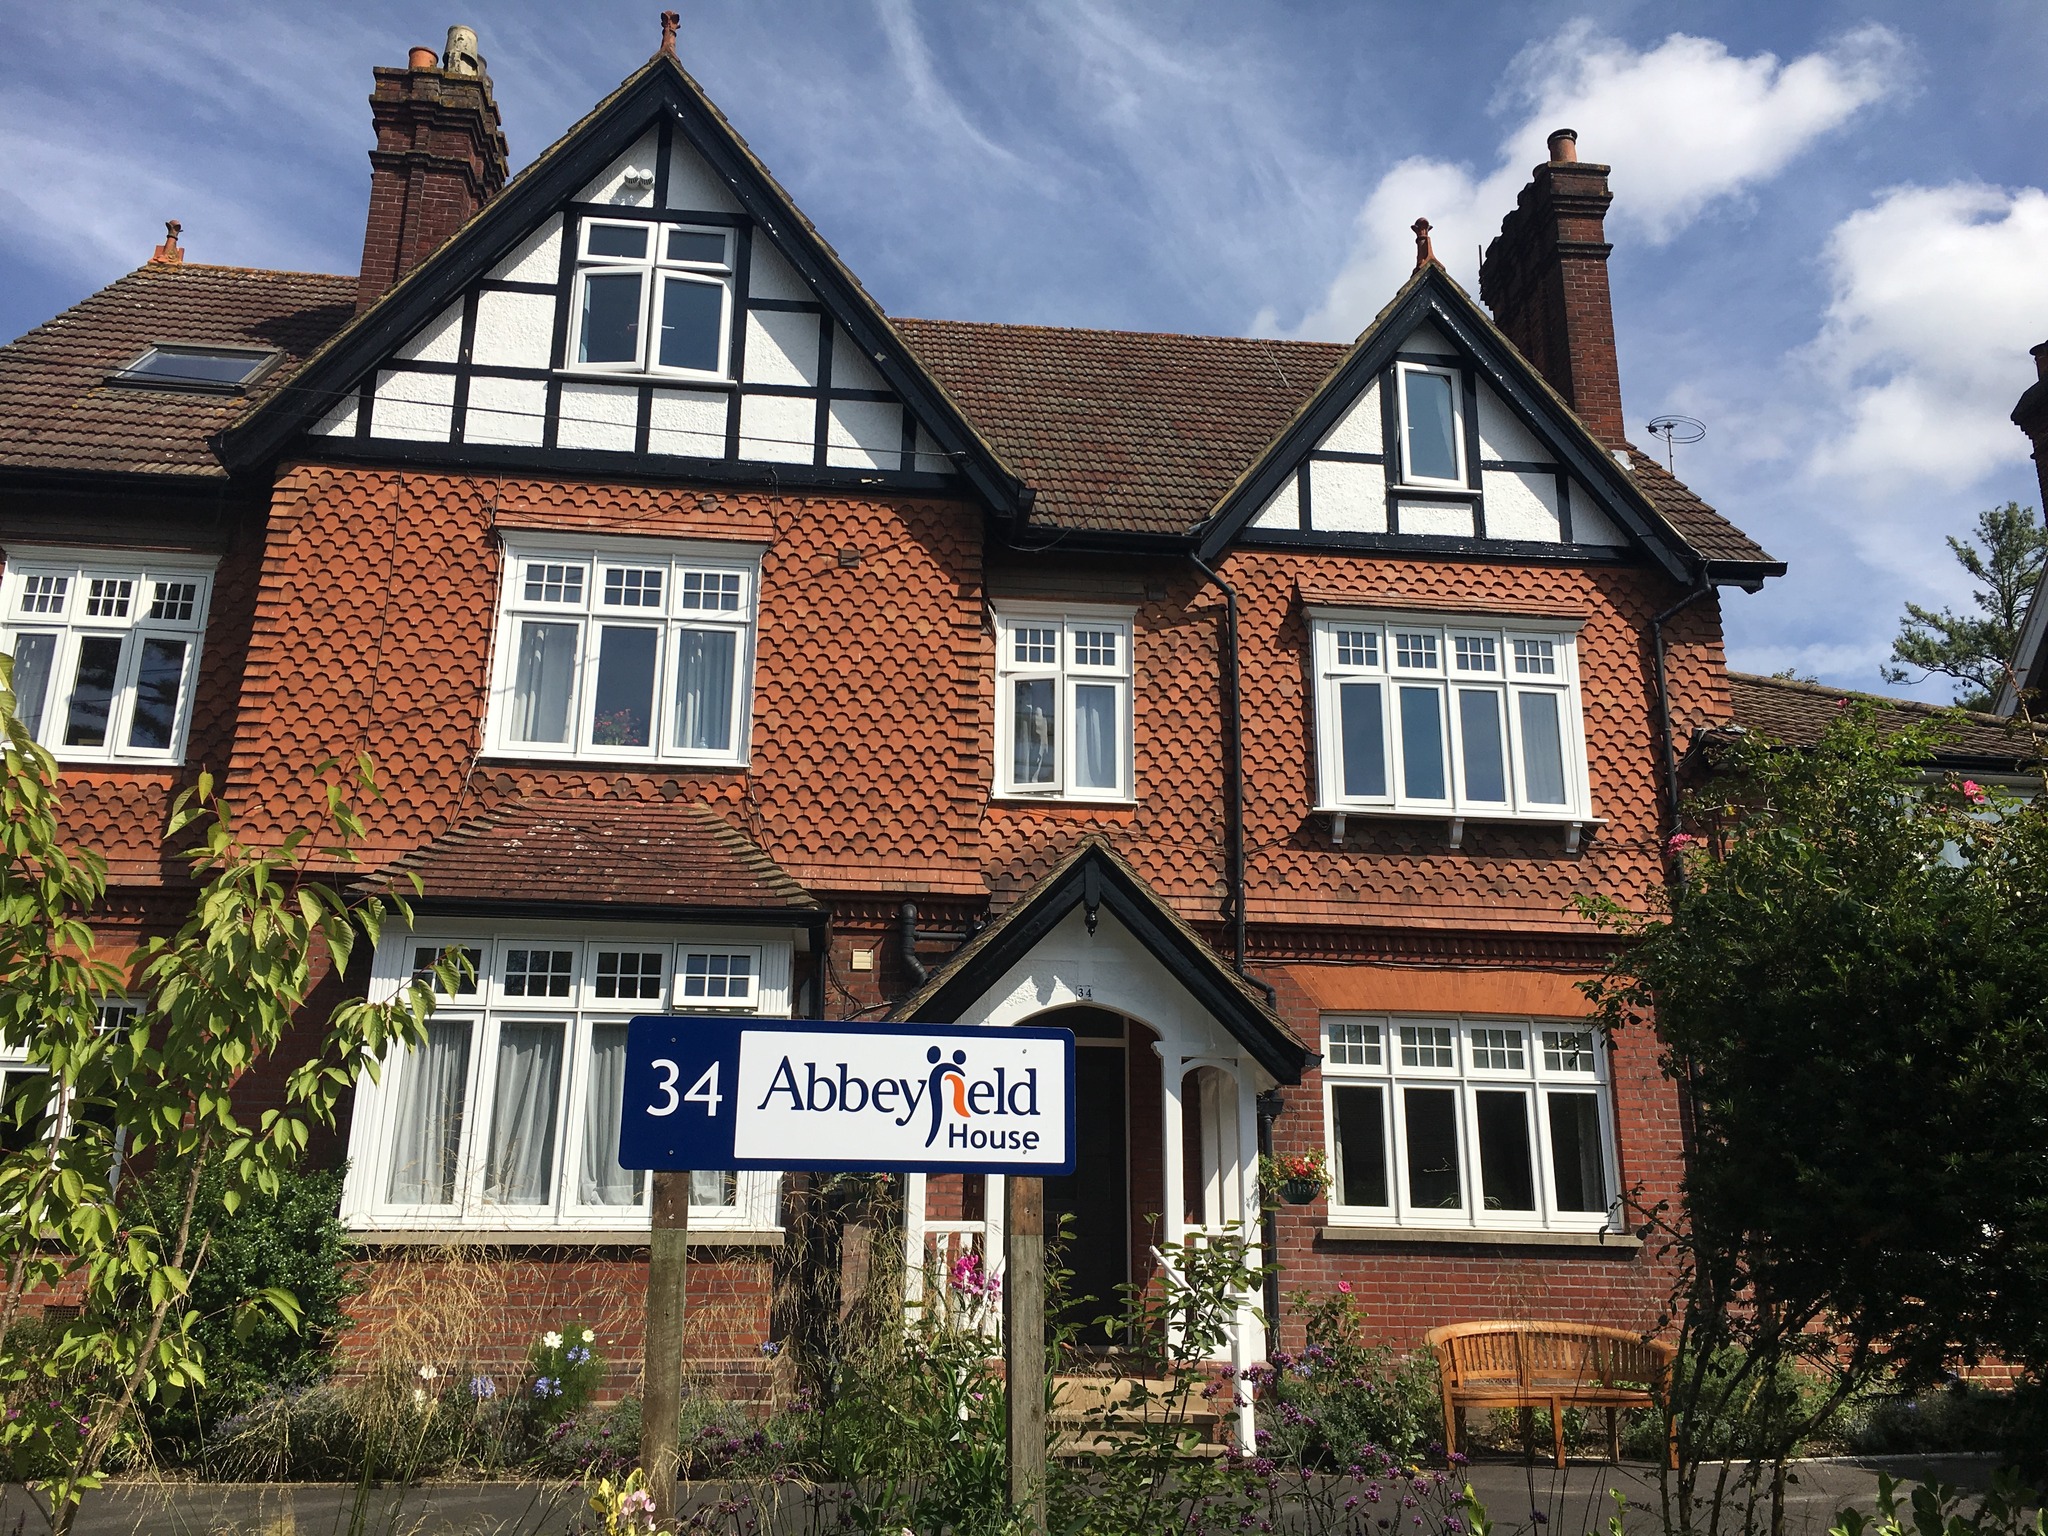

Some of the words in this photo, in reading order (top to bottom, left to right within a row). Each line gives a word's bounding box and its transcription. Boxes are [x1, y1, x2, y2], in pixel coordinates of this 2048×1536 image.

[1078, 988, 1092, 998] 34
[646, 1059, 723, 1117] 34
[757, 1045, 1041, 1149] Abbeyfield
[948, 1123, 1040, 1150] House
